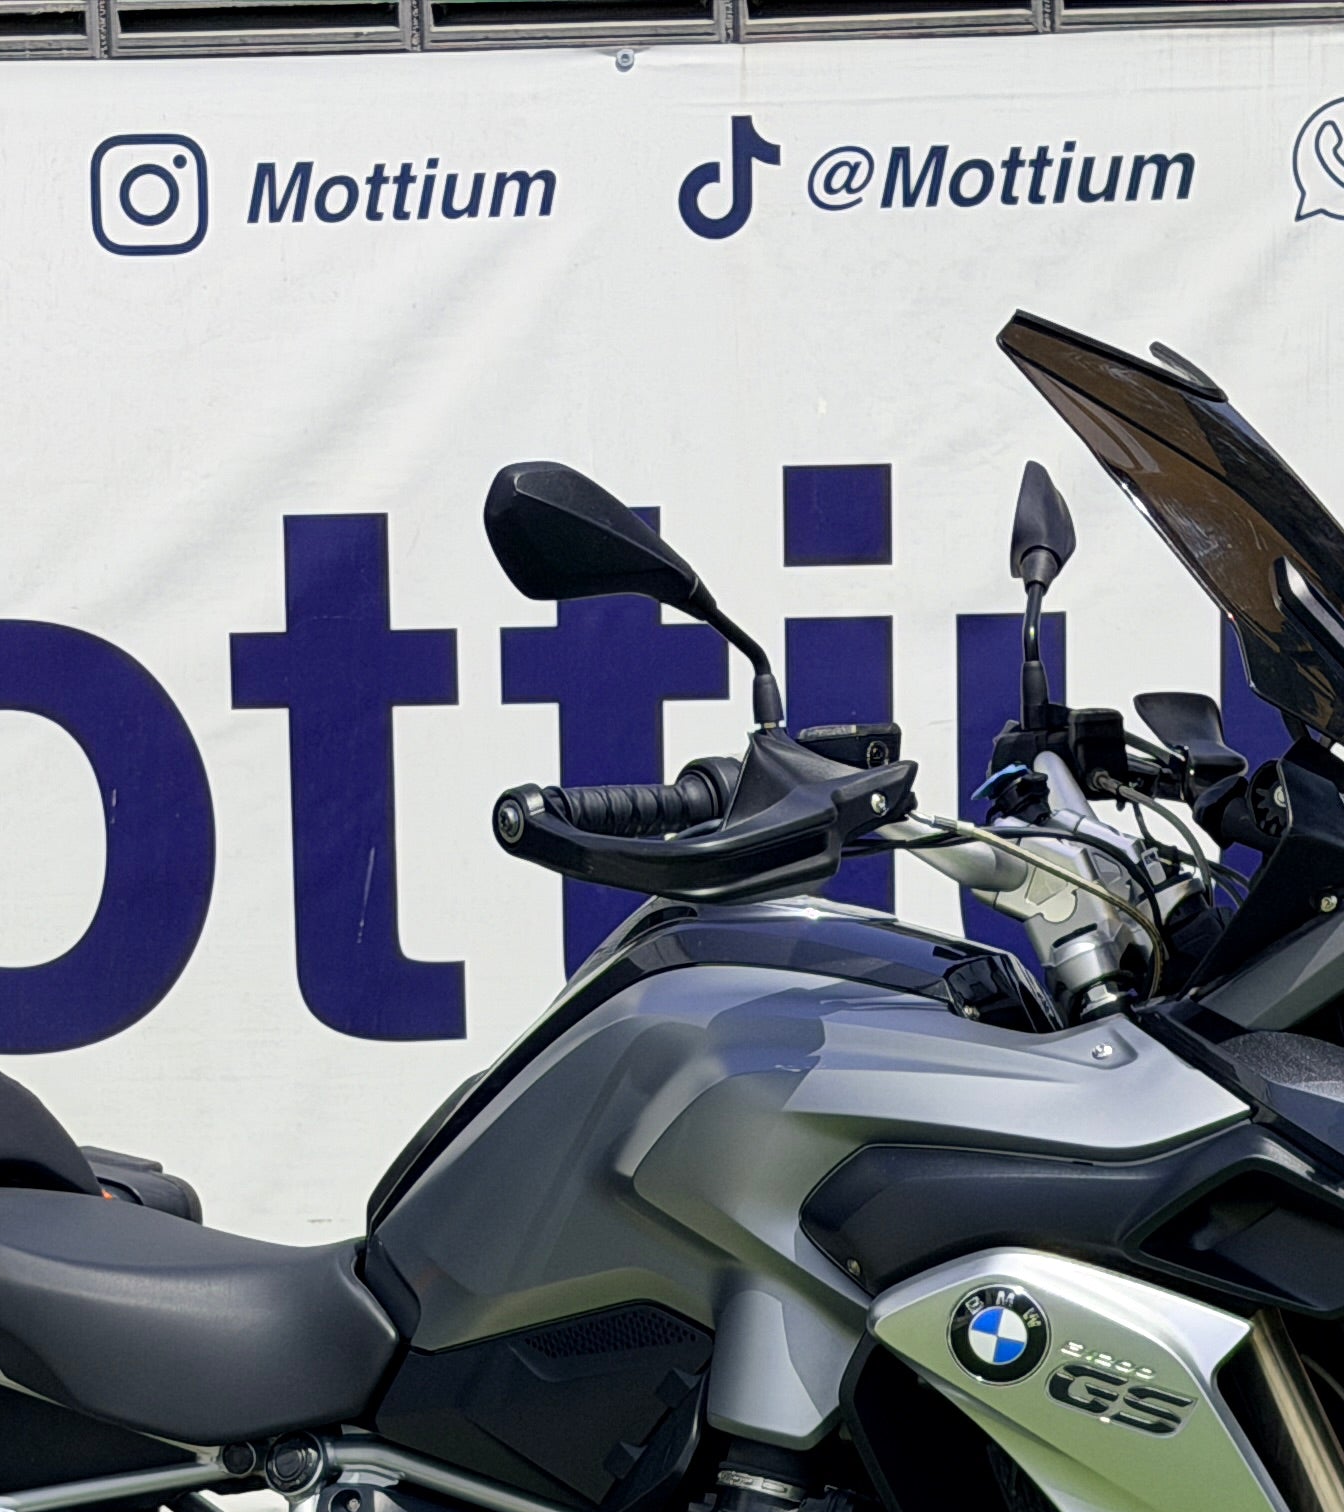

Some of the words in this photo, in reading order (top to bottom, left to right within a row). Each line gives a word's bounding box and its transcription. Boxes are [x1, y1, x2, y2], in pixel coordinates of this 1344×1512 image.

[246, 156, 557, 225] Mottium
[806, 140, 1196, 212] @Mottium
[965, 1290, 1042, 1328] BMW
[1046, 1361, 1197, 1437] GS
